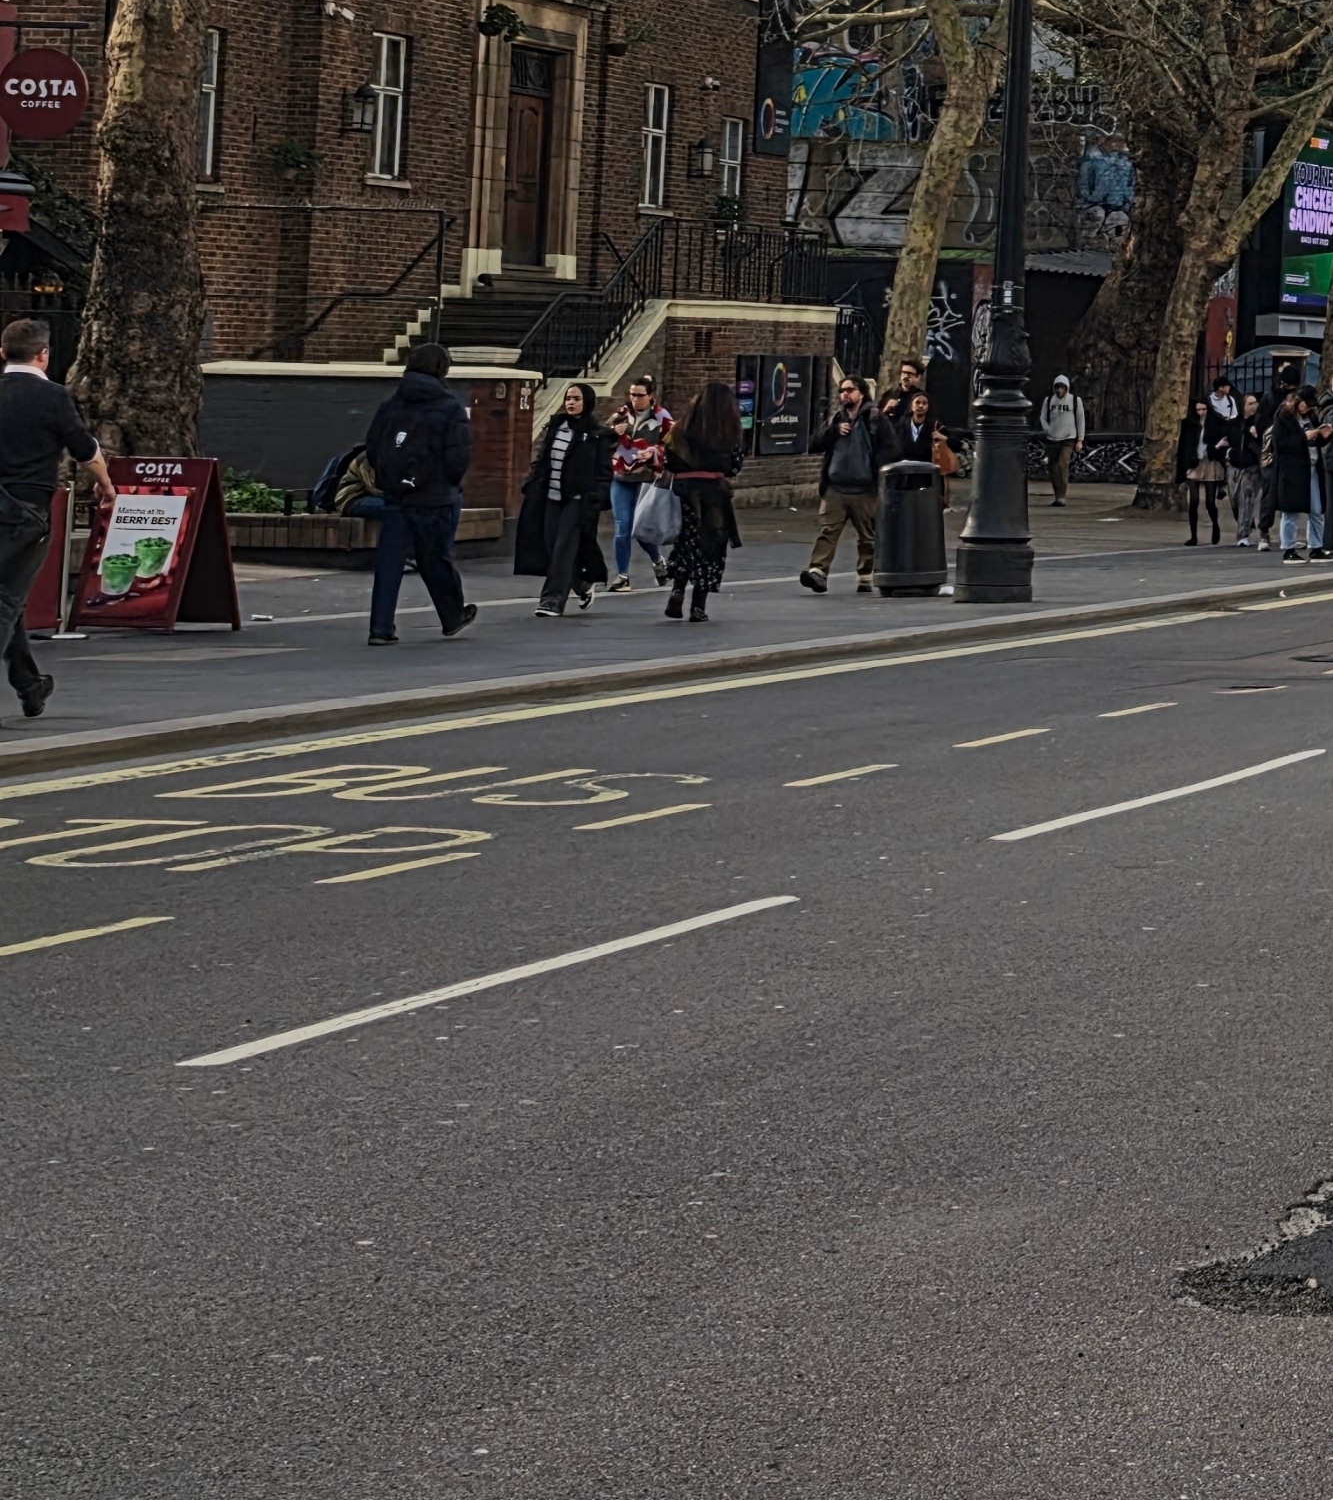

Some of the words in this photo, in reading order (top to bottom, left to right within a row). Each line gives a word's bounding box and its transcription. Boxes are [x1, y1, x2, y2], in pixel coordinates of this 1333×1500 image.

[5, 78, 77, 98] COSTA
[20, 100, 61, 109] COFFEE
[1293, 161, 1321, 187] YOUR
[135, 463, 183, 476] COSTA
[117, 507, 146, 515] Matcha
[115, 516, 150, 525] BERRY
[150, 517, 178, 525] BEST
[154, 764, 713, 806] BUS
[0, 817, 495, 873] TOP
